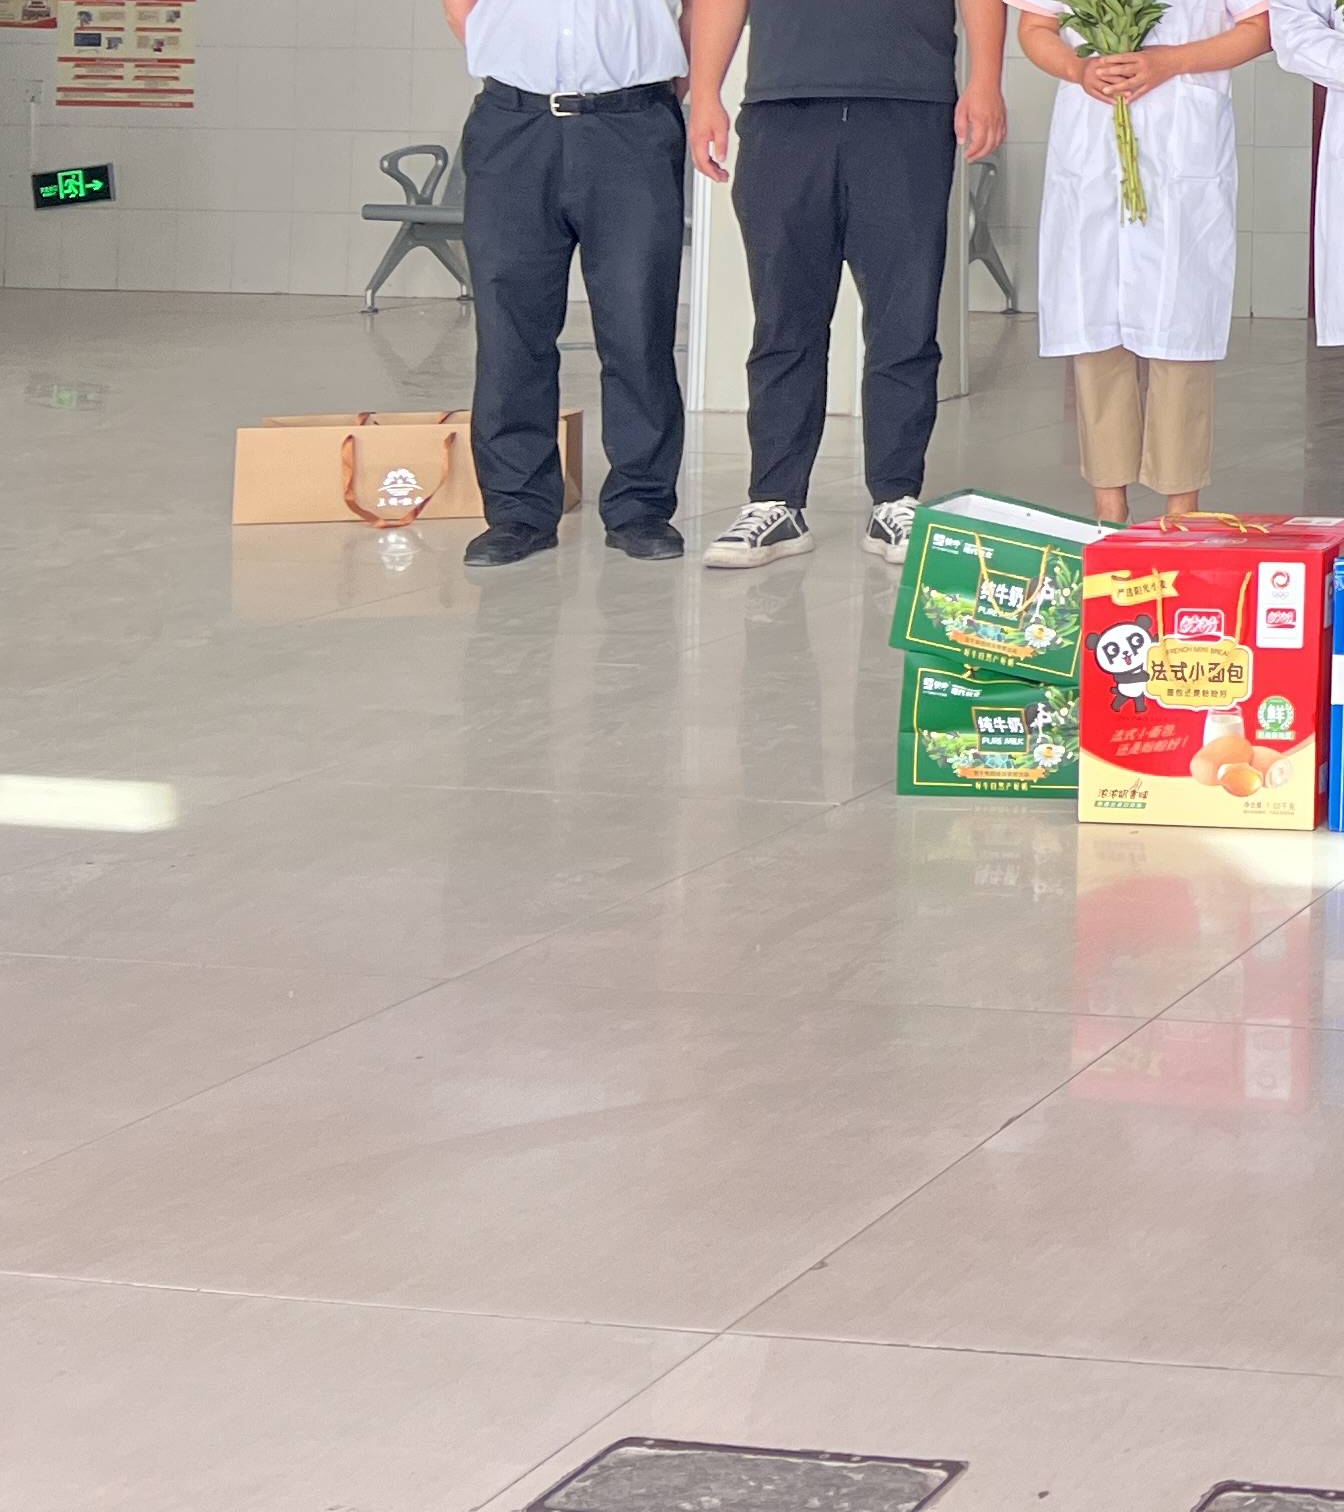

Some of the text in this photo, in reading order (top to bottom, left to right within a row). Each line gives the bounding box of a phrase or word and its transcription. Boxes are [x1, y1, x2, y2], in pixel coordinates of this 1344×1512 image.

[1151, 660, 1245, 684] 法式小面包
[977, 716, 1025, 735] 纯牛奶
